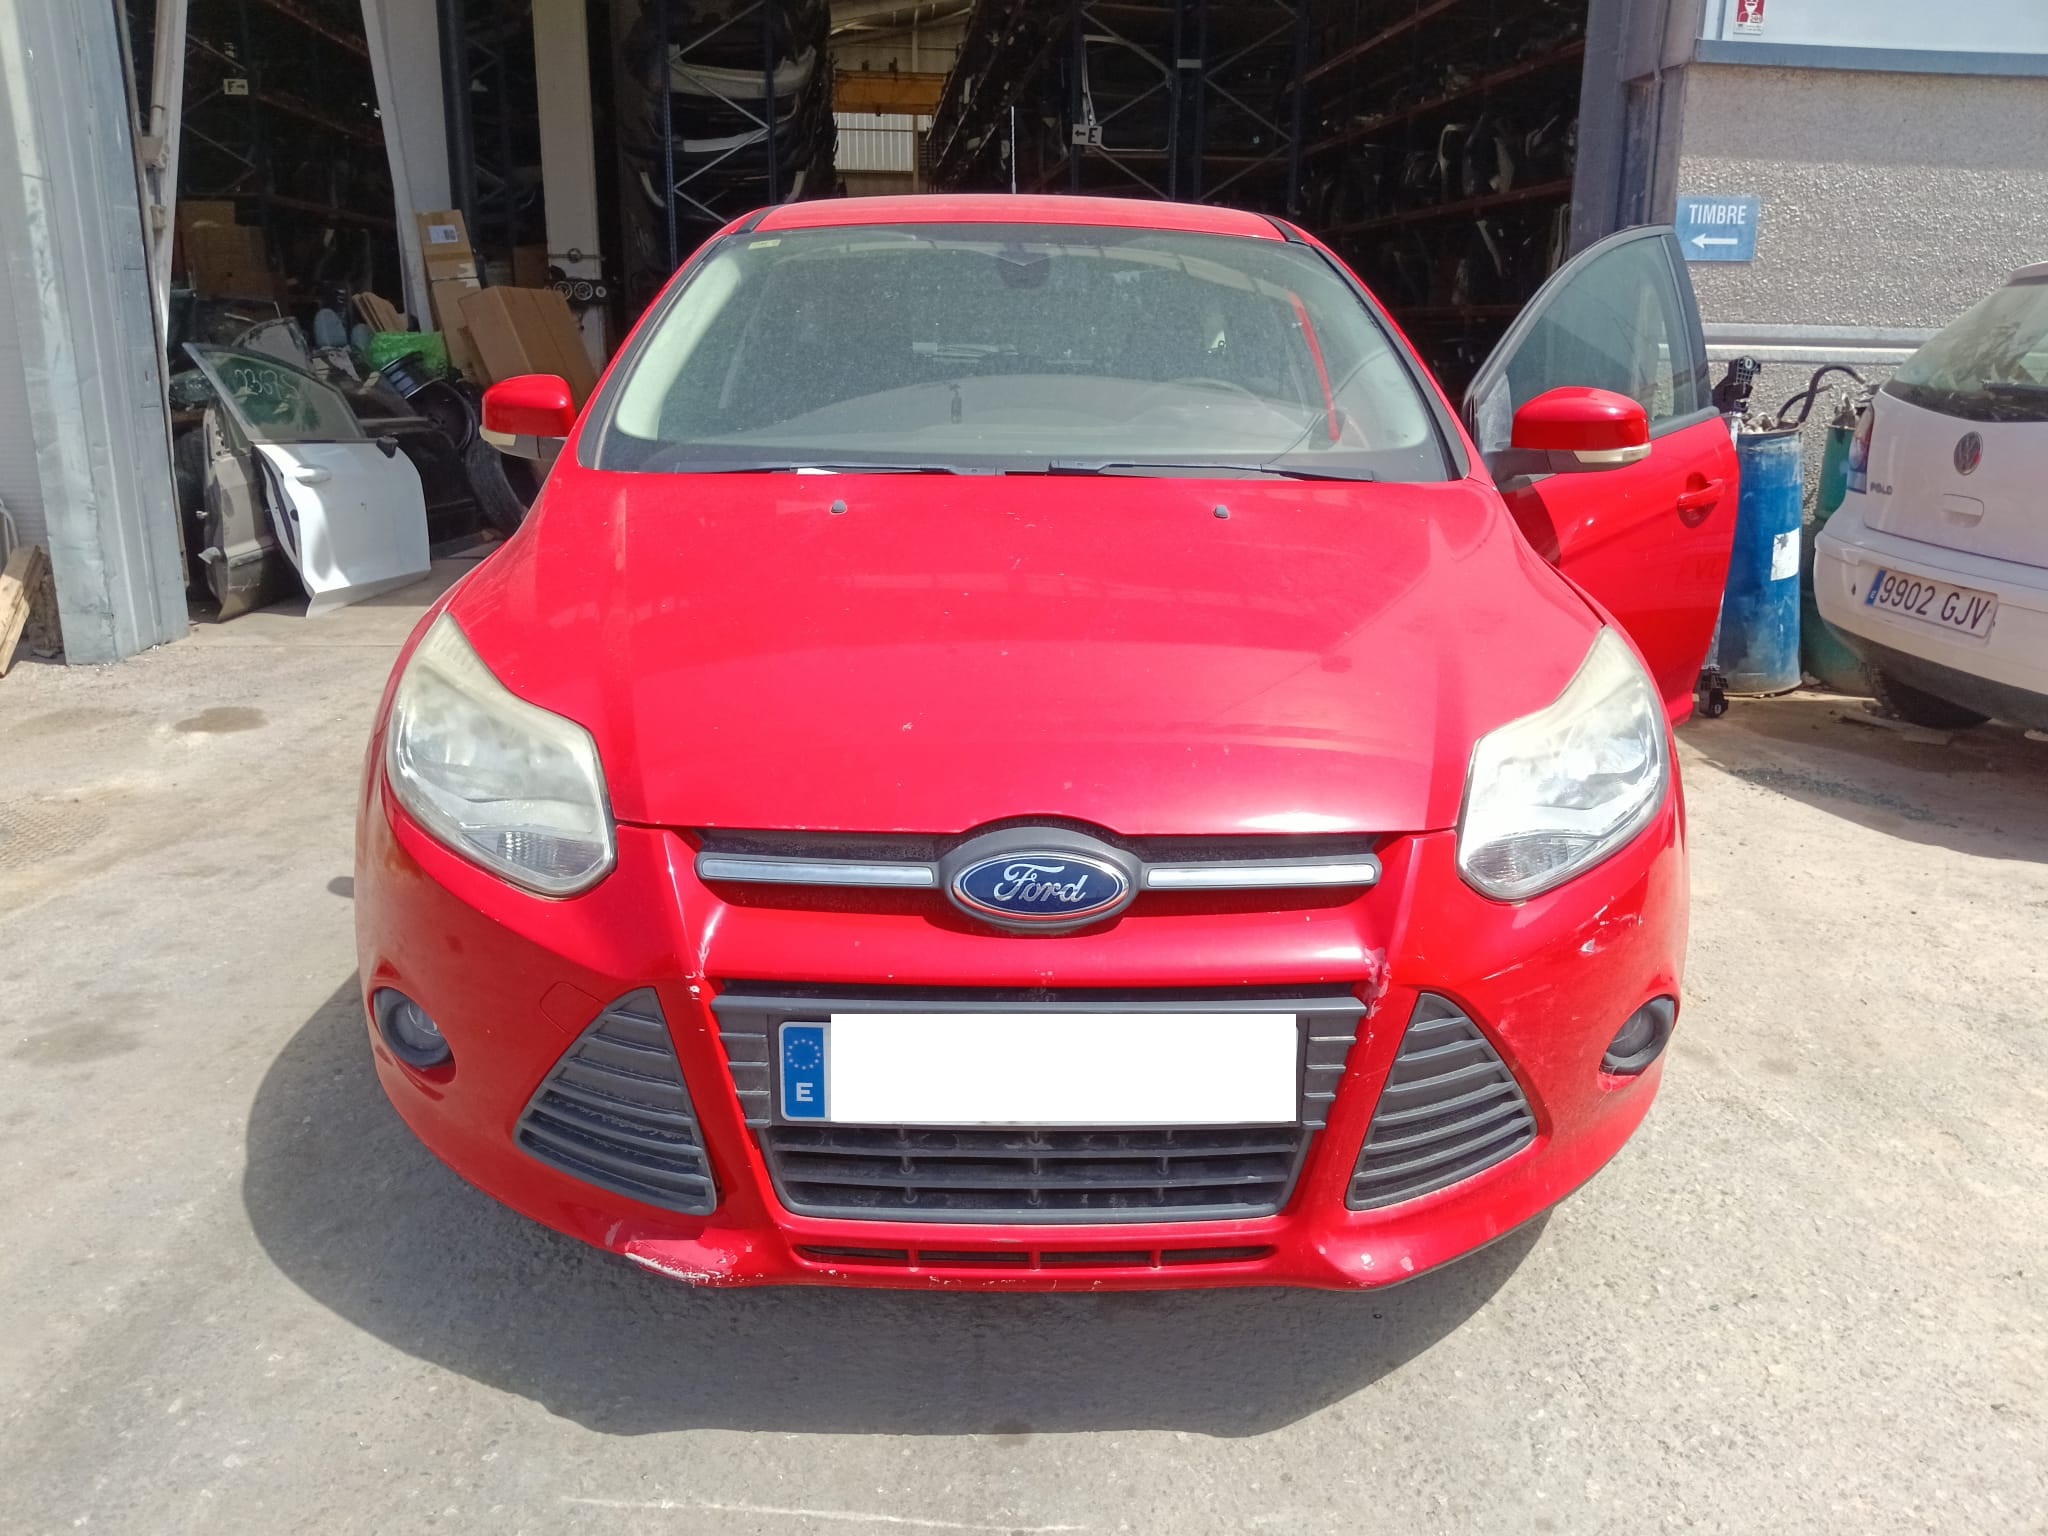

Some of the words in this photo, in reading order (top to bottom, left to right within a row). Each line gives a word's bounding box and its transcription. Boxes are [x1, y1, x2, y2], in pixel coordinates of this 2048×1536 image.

[1088, 127, 1098, 144] E
[1689, 204, 1747, 225] TIMBRE
[1870, 482, 1893, 496] POLO
[1879, 575, 1936, 616] 9902
[1940, 591, 1991, 630] GJV
[993, 862, 1088, 903] Ford
[796, 1082, 814, 1102] E
